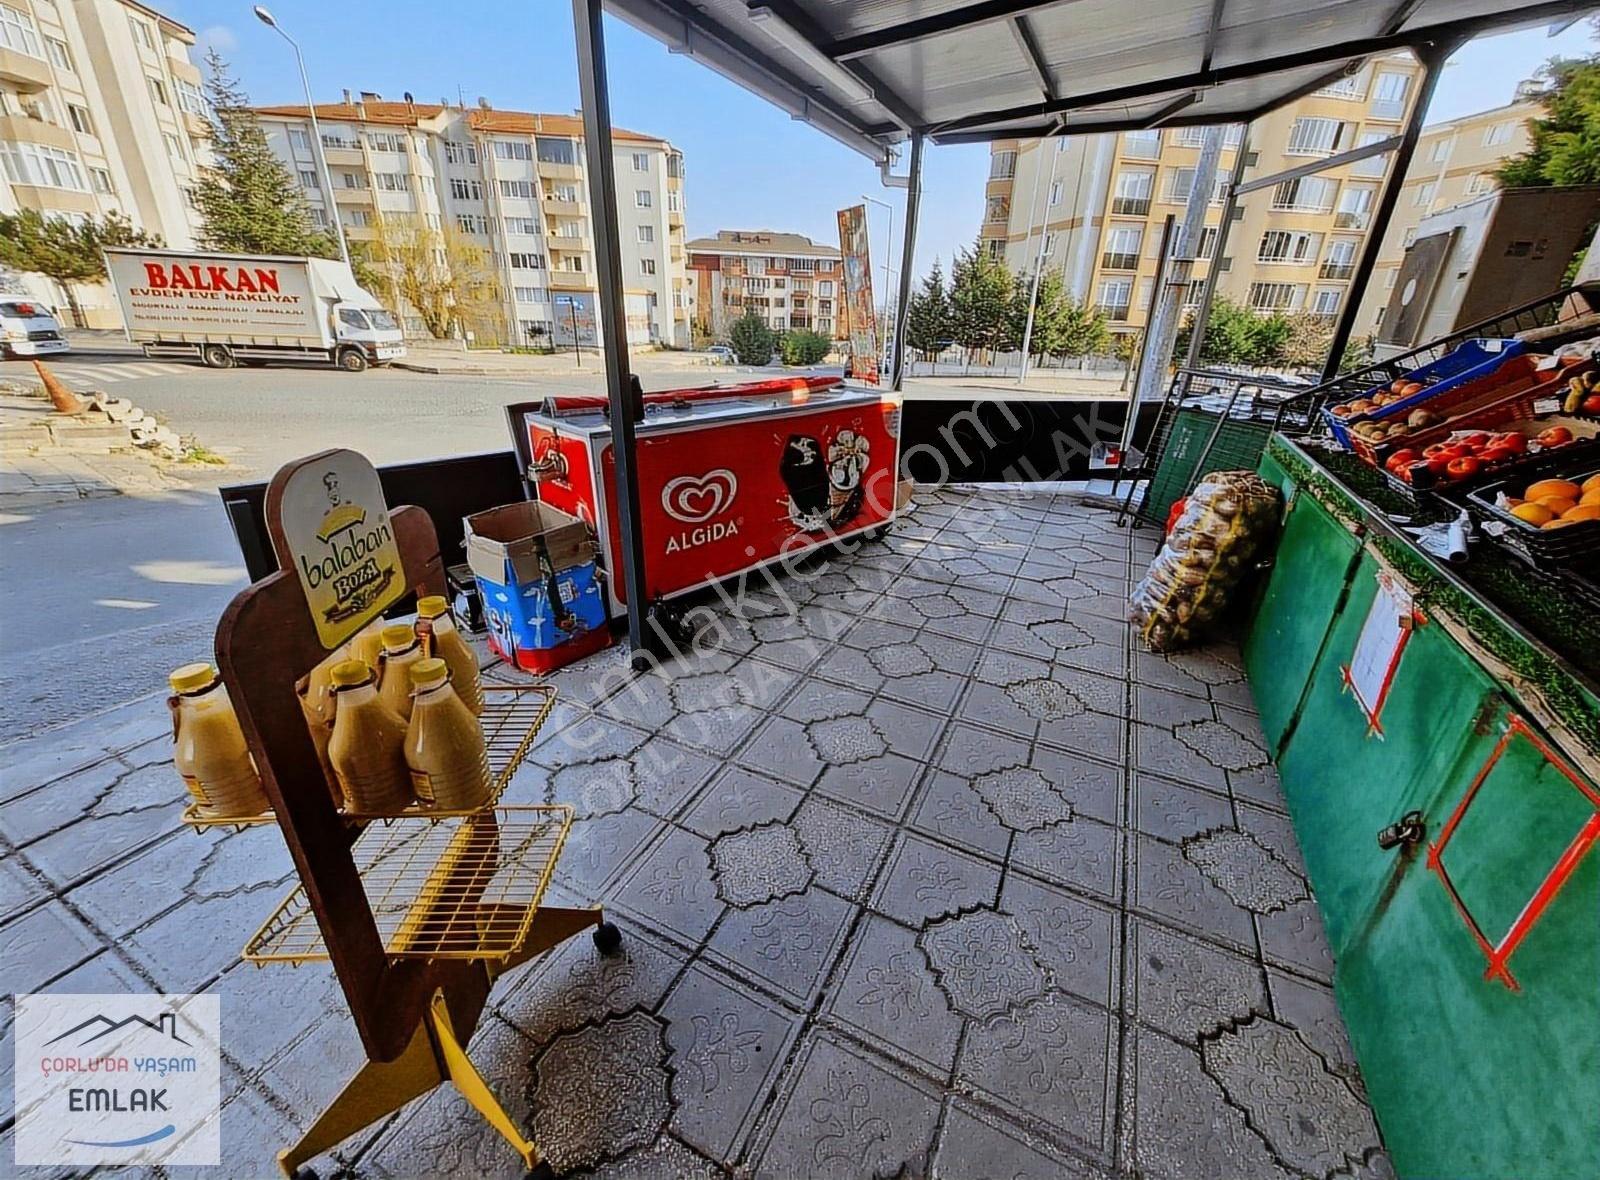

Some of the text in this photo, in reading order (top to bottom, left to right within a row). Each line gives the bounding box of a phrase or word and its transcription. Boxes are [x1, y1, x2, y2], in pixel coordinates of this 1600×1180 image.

[129, 288, 184, 298] EVDEN
[190, 291, 219, 300] EVE
[143, 263, 281, 293] BALKAN
[301, 525, 392, 589] balaban
[333, 558, 382, 603] BOZA
